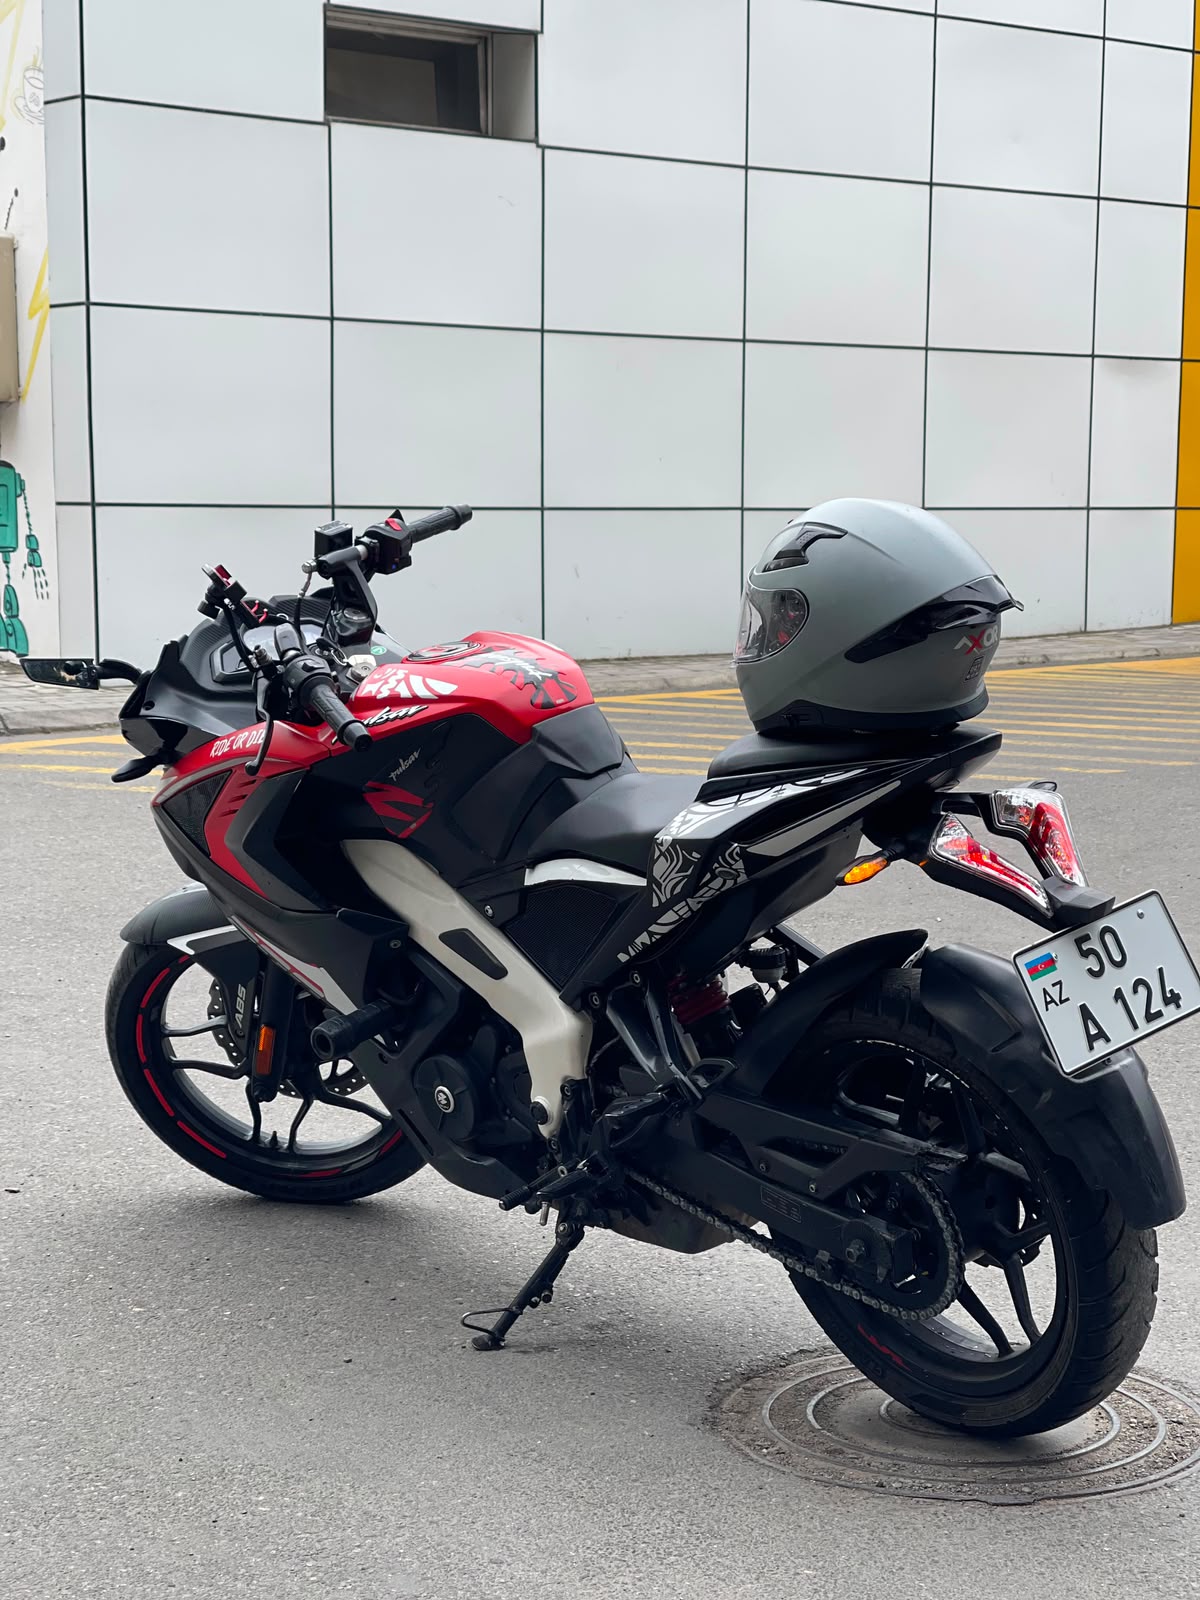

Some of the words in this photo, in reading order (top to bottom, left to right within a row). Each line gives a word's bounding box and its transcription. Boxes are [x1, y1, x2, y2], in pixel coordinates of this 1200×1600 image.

[210, 736, 235, 758] RIDE
[233, 731, 249, 750] OR
[388, 747, 422, 782] pulsar
[1074, 925, 1127, 978] 50
[235, 983, 246, 1029] ABS
[1042, 979, 1070, 1012] AZ
[1079, 1002, 1112, 1052] A
[1113, 965, 1182, 1031] 124
